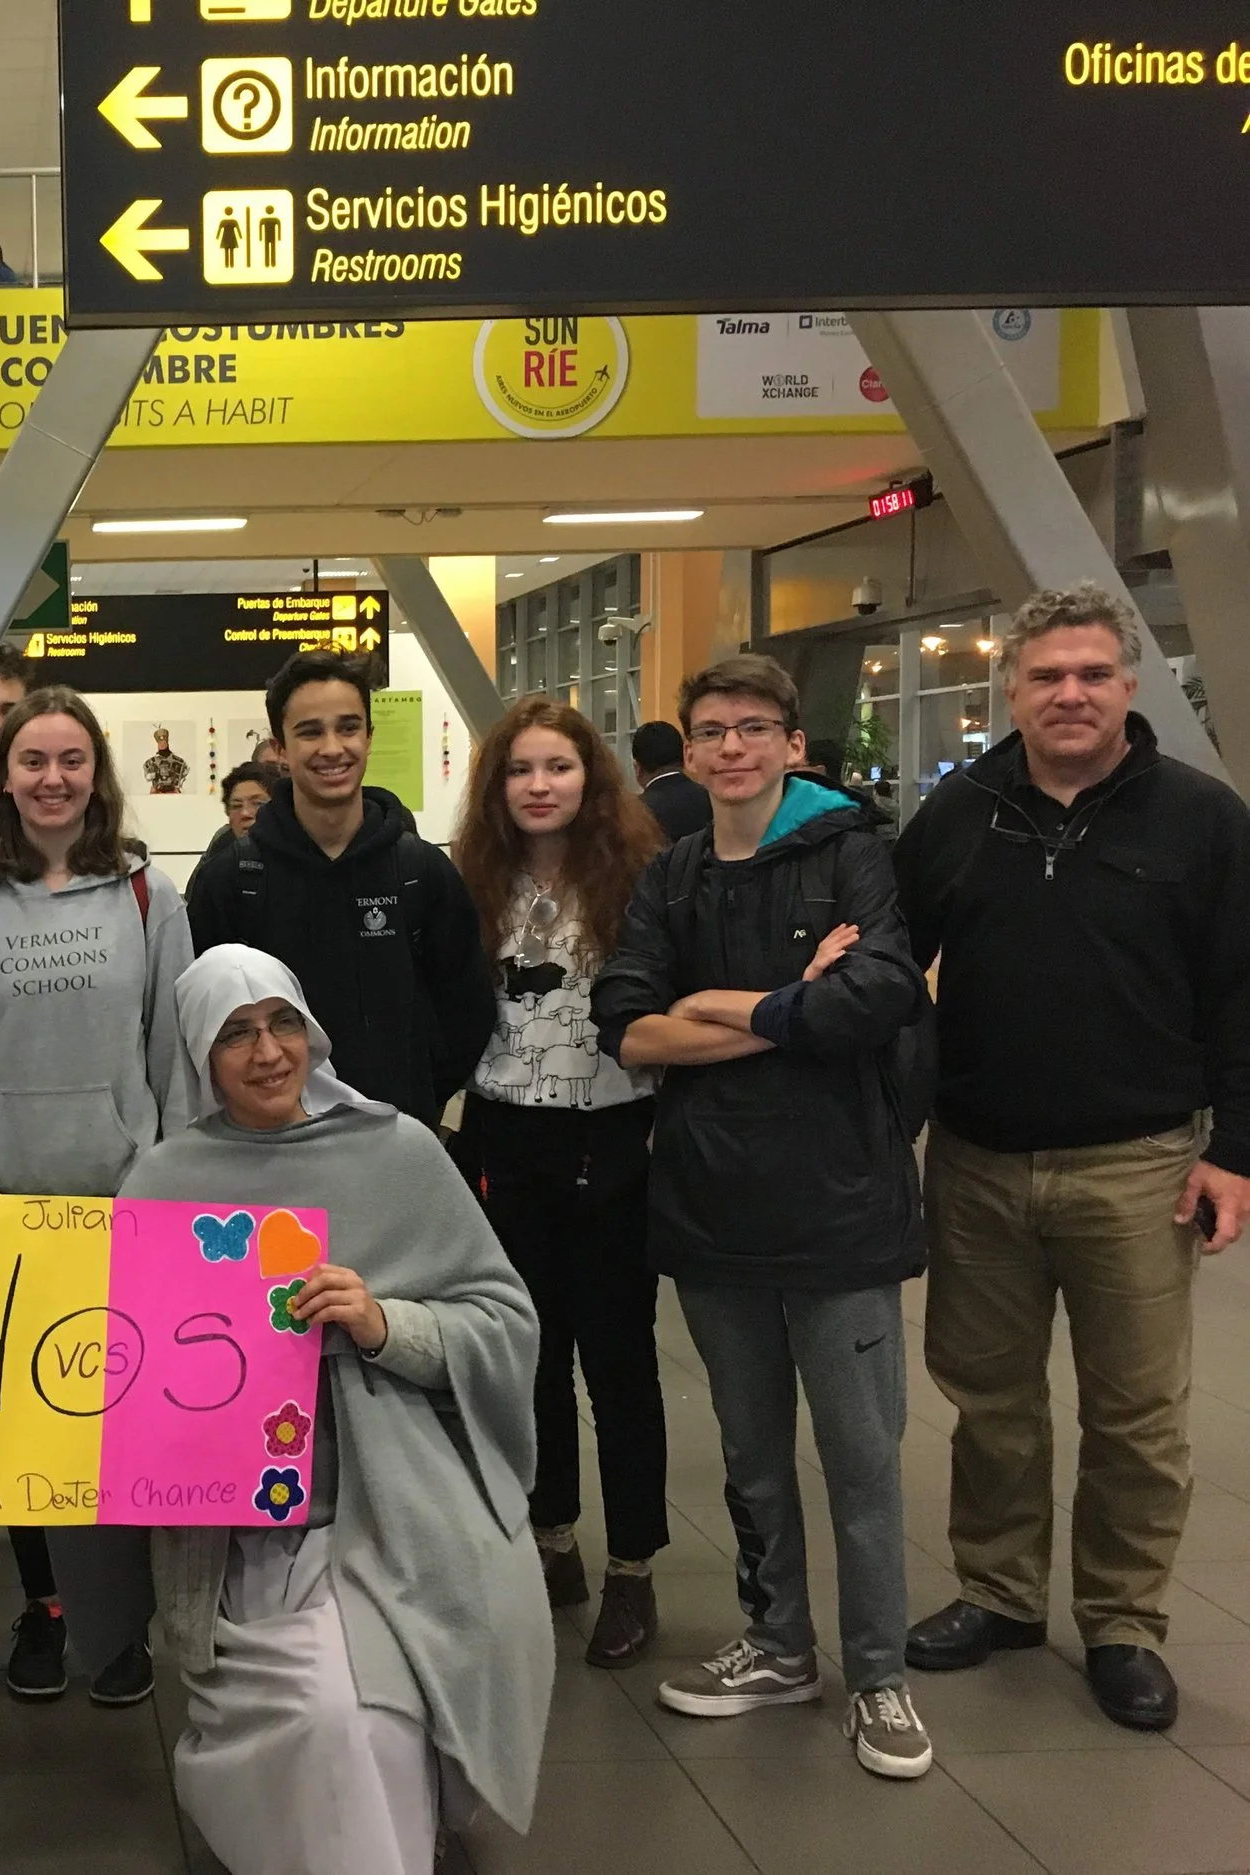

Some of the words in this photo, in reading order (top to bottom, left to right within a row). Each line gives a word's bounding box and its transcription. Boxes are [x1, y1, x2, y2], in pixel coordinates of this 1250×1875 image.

[309, 0, 447, 25] Departure
[459, 0, 536, 16] Gates
[1065, 42, 1204, 85] Oficinas
[306, 54, 513, 99] Información
[309, 115, 470, 151] Information
[306, 187, 466, 231] Servicios
[480, 183, 667, 236] Higiénicos
[311, 249, 461, 282] Restrooms
[160, 322, 405, 342] OSTUMBRES
[716, 318, 770, 335] Talma
[524, 347, 578, 388] RÍE
[506, 393, 532, 415] NUEVOS
[556, 388, 598, 416] AEROPUERTO
[762, 387, 819, 399] XCHANGE
[173, 399, 195, 426] A
[206, 396, 295, 426] HABIT
[237, 597, 270, 610] Puertas
[272, 597, 283, 609] de
[286, 597, 330, 610] Embarque
[273, 611, 308, 622] Departure
[309, 611, 330, 621] Gates
[46, 633, 87, 644] Servicios
[89, 632, 137, 646] Higiénicos
[224, 629, 257, 641] Control
[258, 629, 270, 640] de
[272, 628, 331, 642] Preembarque
[47, 647, 86, 657] Restrooms
[6, 926, 103, 950] VERMONT
[0, 949, 108, 974] COMMONS
[12, 974, 97, 997] SCHOOL
[22, 1199, 138, 1236] Julian
[131, 1476, 236, 1508] Chance
